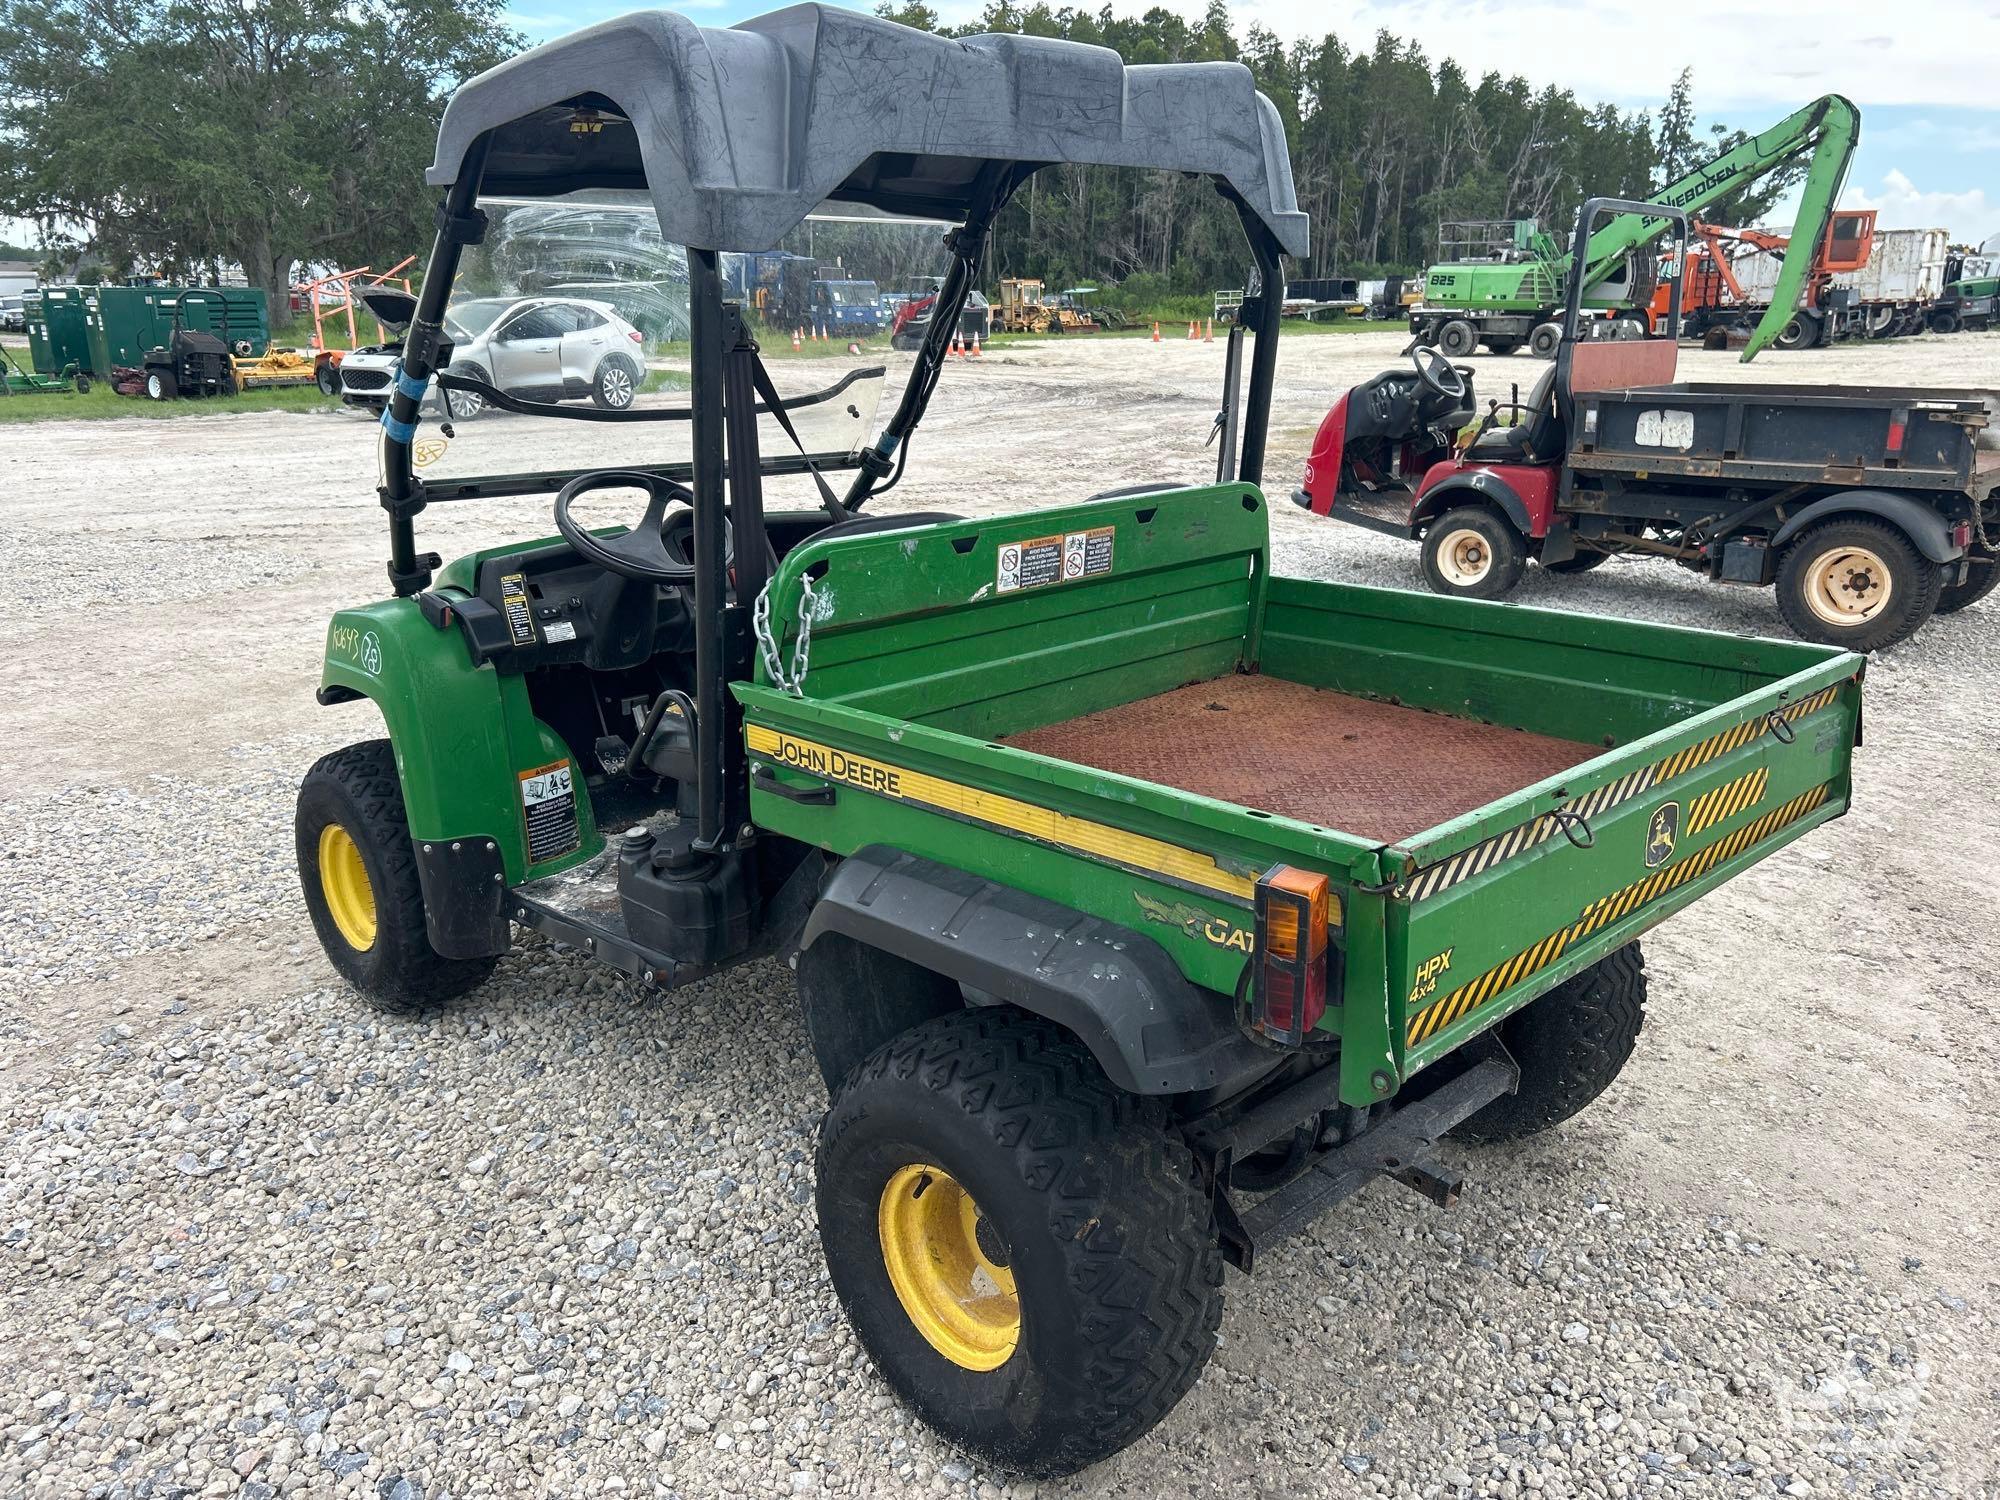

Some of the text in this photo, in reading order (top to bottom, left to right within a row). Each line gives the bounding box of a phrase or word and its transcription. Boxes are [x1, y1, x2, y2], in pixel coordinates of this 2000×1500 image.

[1430, 275, 1456, 286] 825
[774, 736, 900, 794] JOHN DEERE
[1416, 949, 1453, 986] HPX
[1409, 977, 1436, 1002] 4x4
